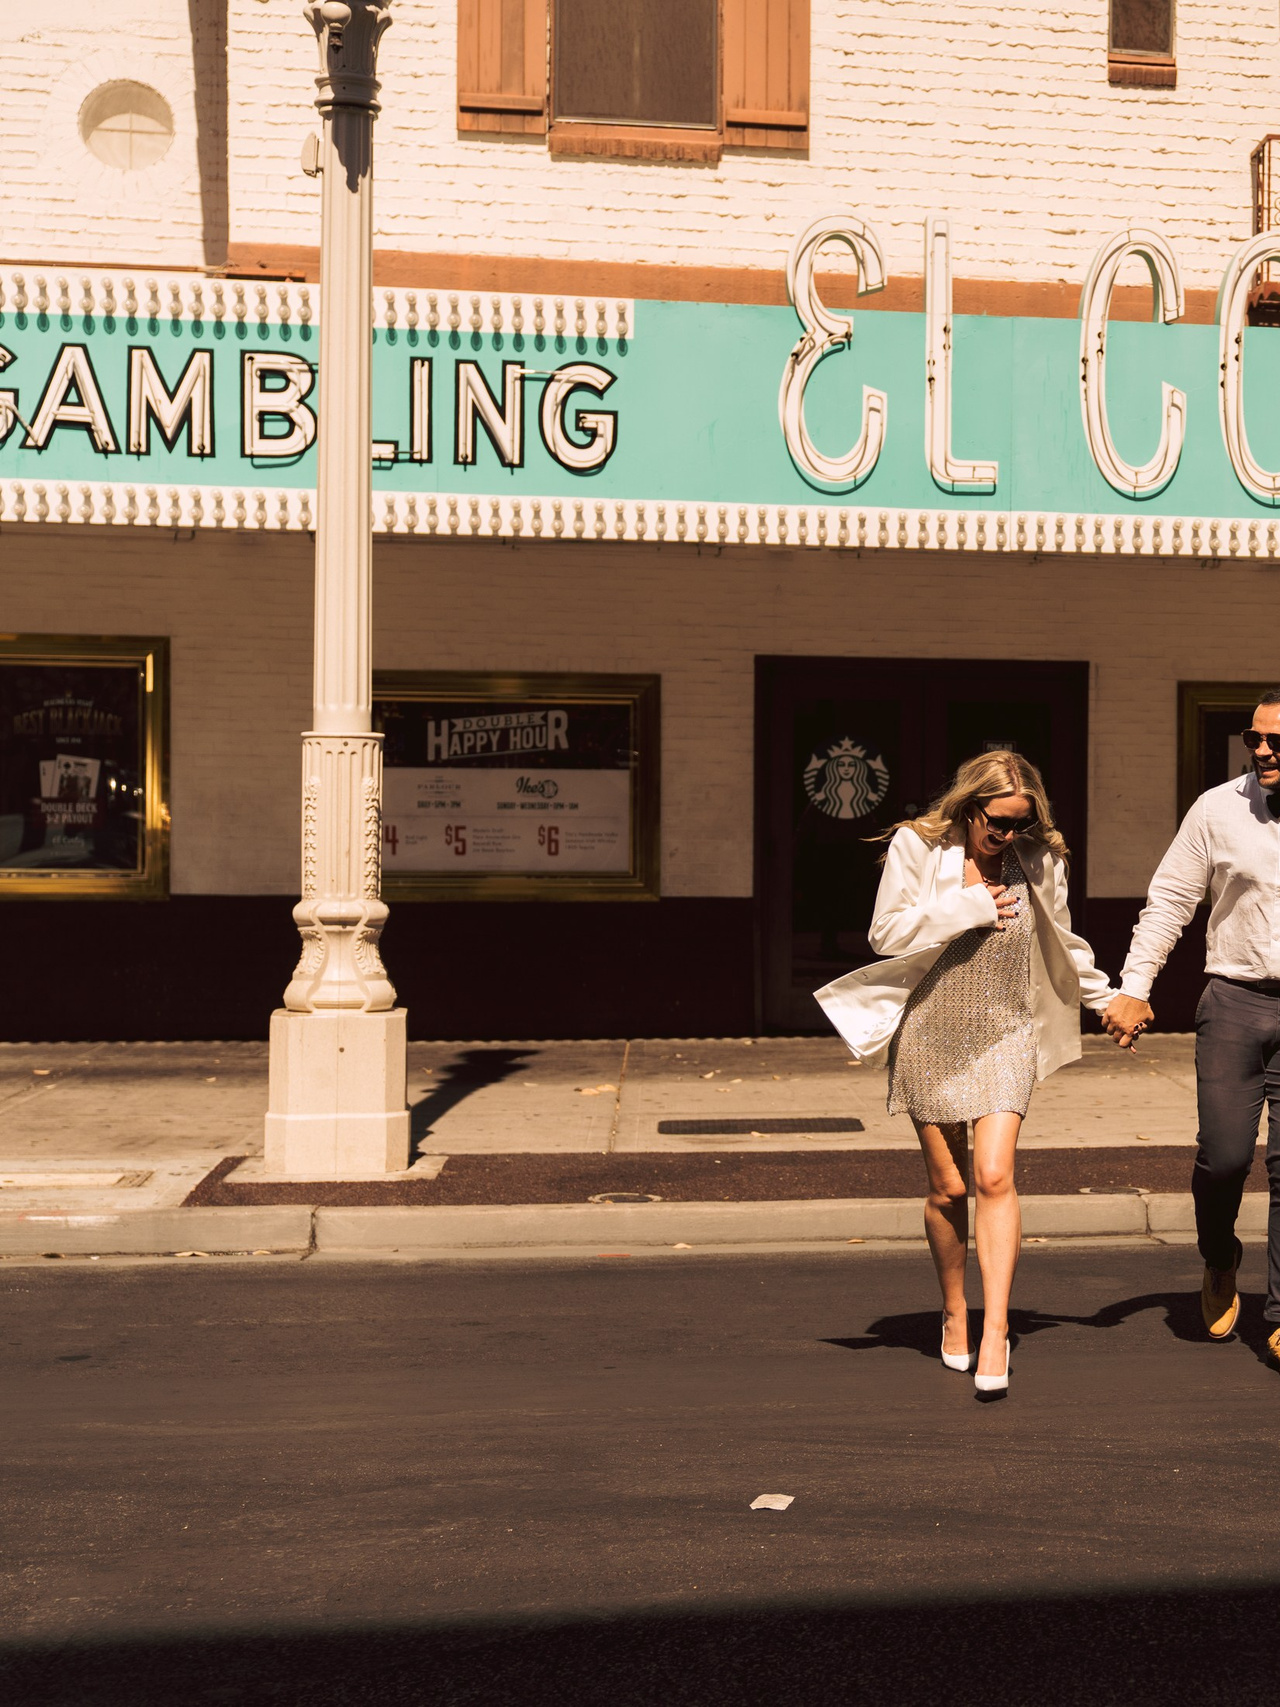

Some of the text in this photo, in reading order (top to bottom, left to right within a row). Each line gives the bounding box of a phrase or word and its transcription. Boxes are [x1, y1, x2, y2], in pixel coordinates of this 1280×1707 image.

[778, 214, 998, 488] EL
[0, 343, 618, 471] AMBING
[427, 709, 569, 761] HAPPY HOUR
[462, 713, 536, 729] DOUBLE
[41, 802, 98, 813] DOUBLE DECK
[61, 813, 93, 824] PAYOUT
[445, 823, 467, 856] $5
[538, 823, 560, 857] $6
